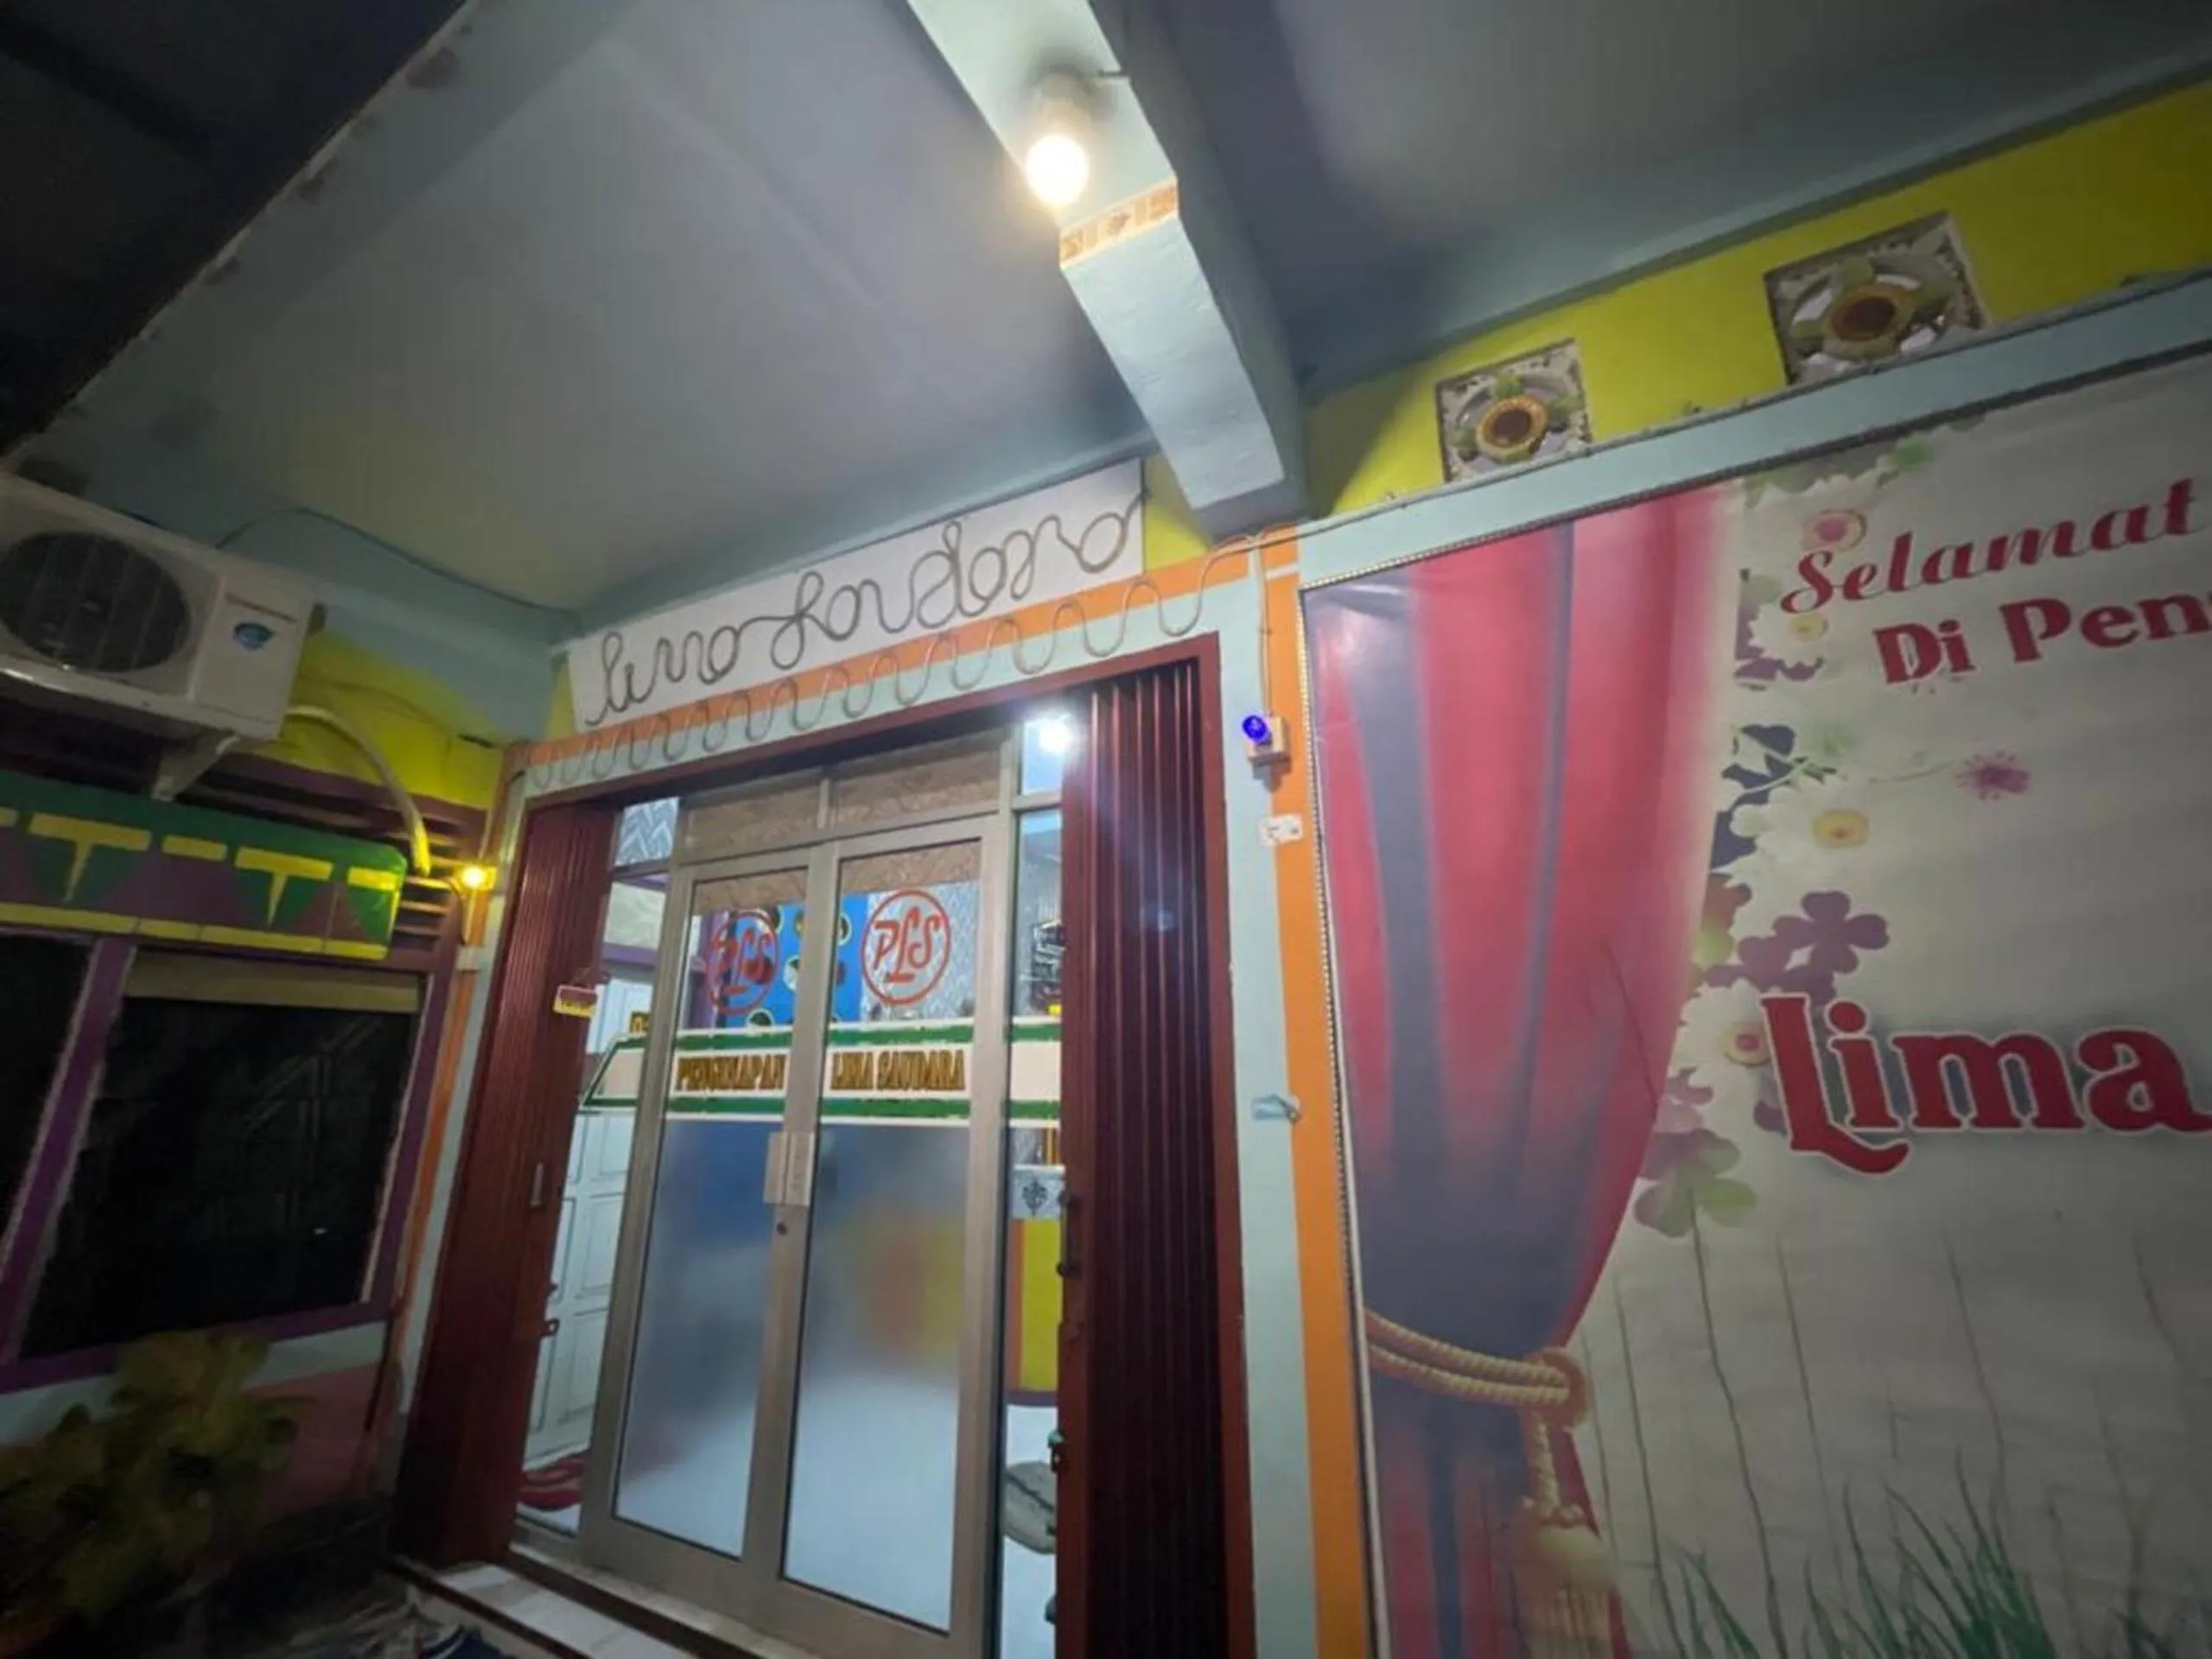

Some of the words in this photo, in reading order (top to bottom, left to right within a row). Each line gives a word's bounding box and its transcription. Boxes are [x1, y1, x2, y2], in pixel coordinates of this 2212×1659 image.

[1780, 478, 2200, 613] Selamat
[1872, 619, 1975, 684] Di
[1999, 584, 2212, 663] Pen
[872, 906, 941, 983] PLS
[1758, 993, 2212, 1174] Lima
